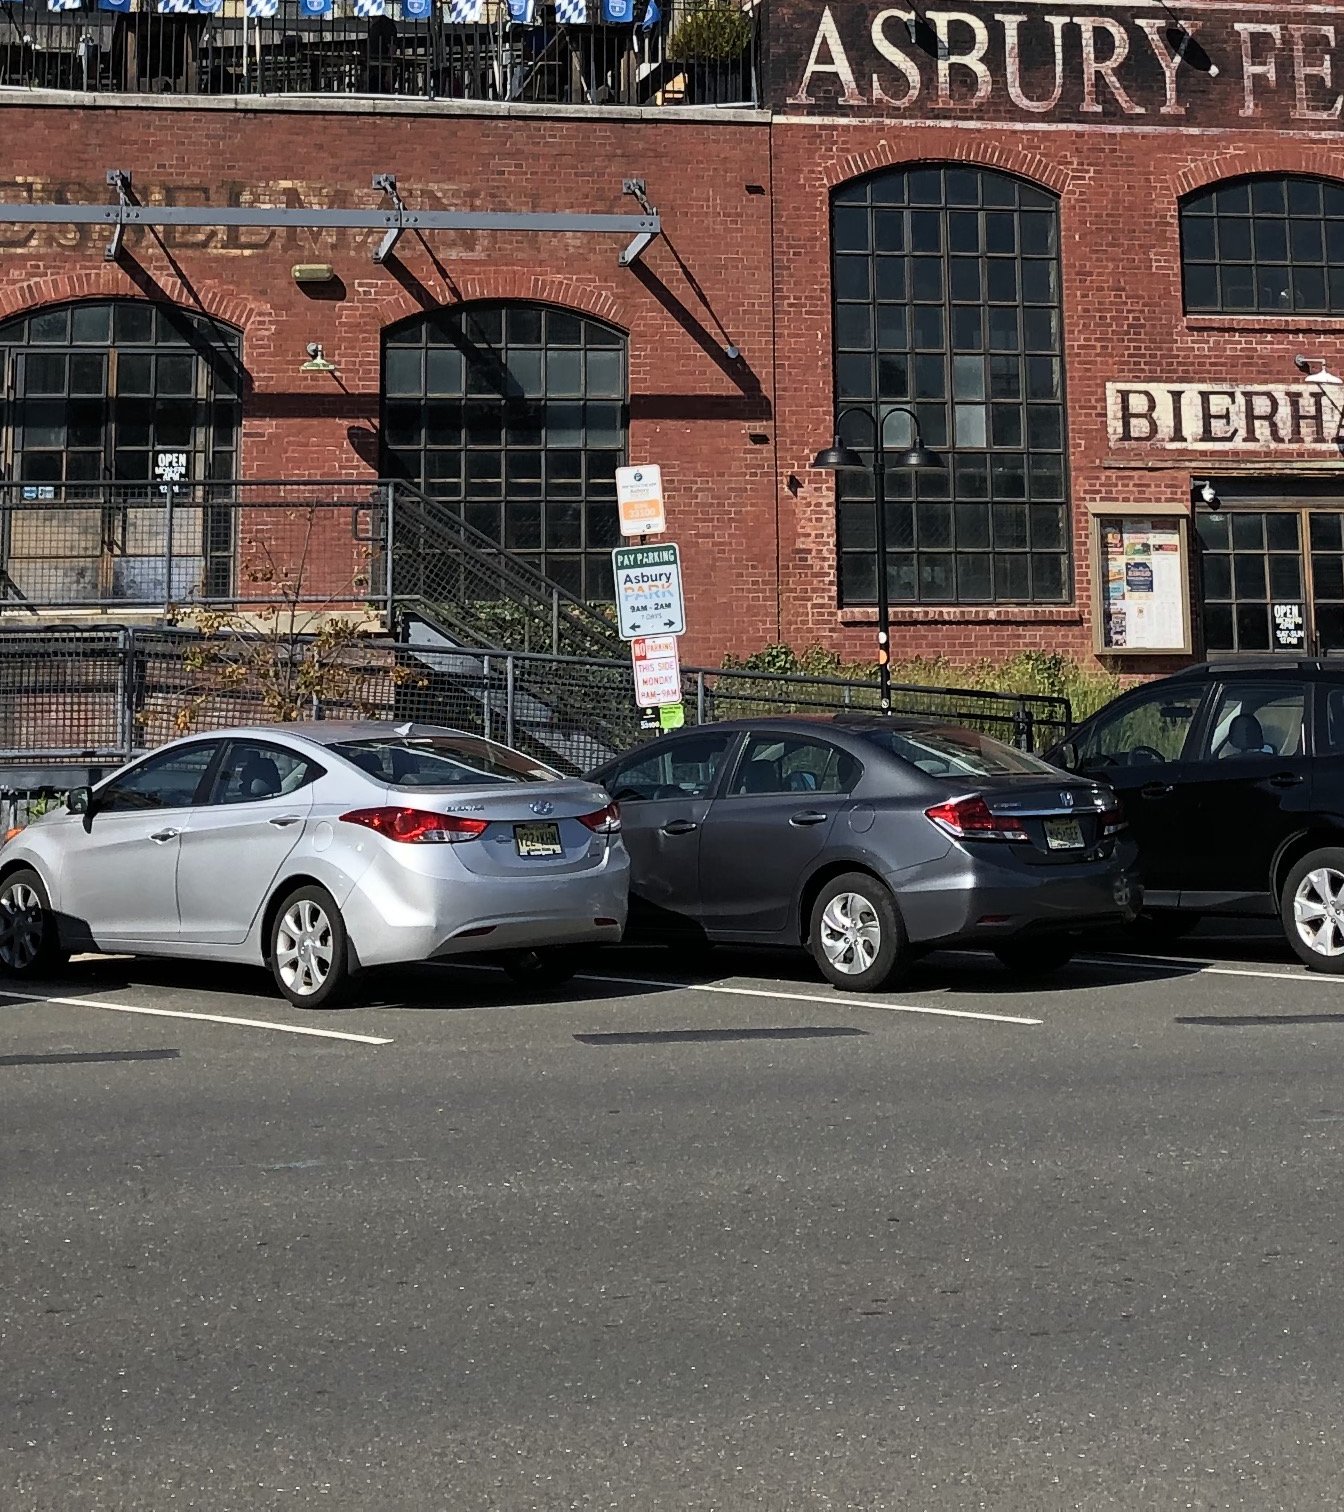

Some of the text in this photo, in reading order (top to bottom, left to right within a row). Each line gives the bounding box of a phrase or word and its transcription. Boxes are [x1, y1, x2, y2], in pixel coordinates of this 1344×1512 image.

[786, 4, 1203, 117] ASBURY
[158, 453, 186, 467] OPEN
[617, 549, 675, 567] PAY PARKING
[623, 571, 672, 585] Asbury
[623, 582, 674, 602] PARK
[630, 604, 648, 613] 9AM
[654, 602, 672, 611] 2AM
[1274, 604, 1299, 618] OPEN
[634, 642, 673, 657] NO PARKING
[638, 661, 675, 673] THIS SIDE
[642, 675, 673, 686] MONDAY
